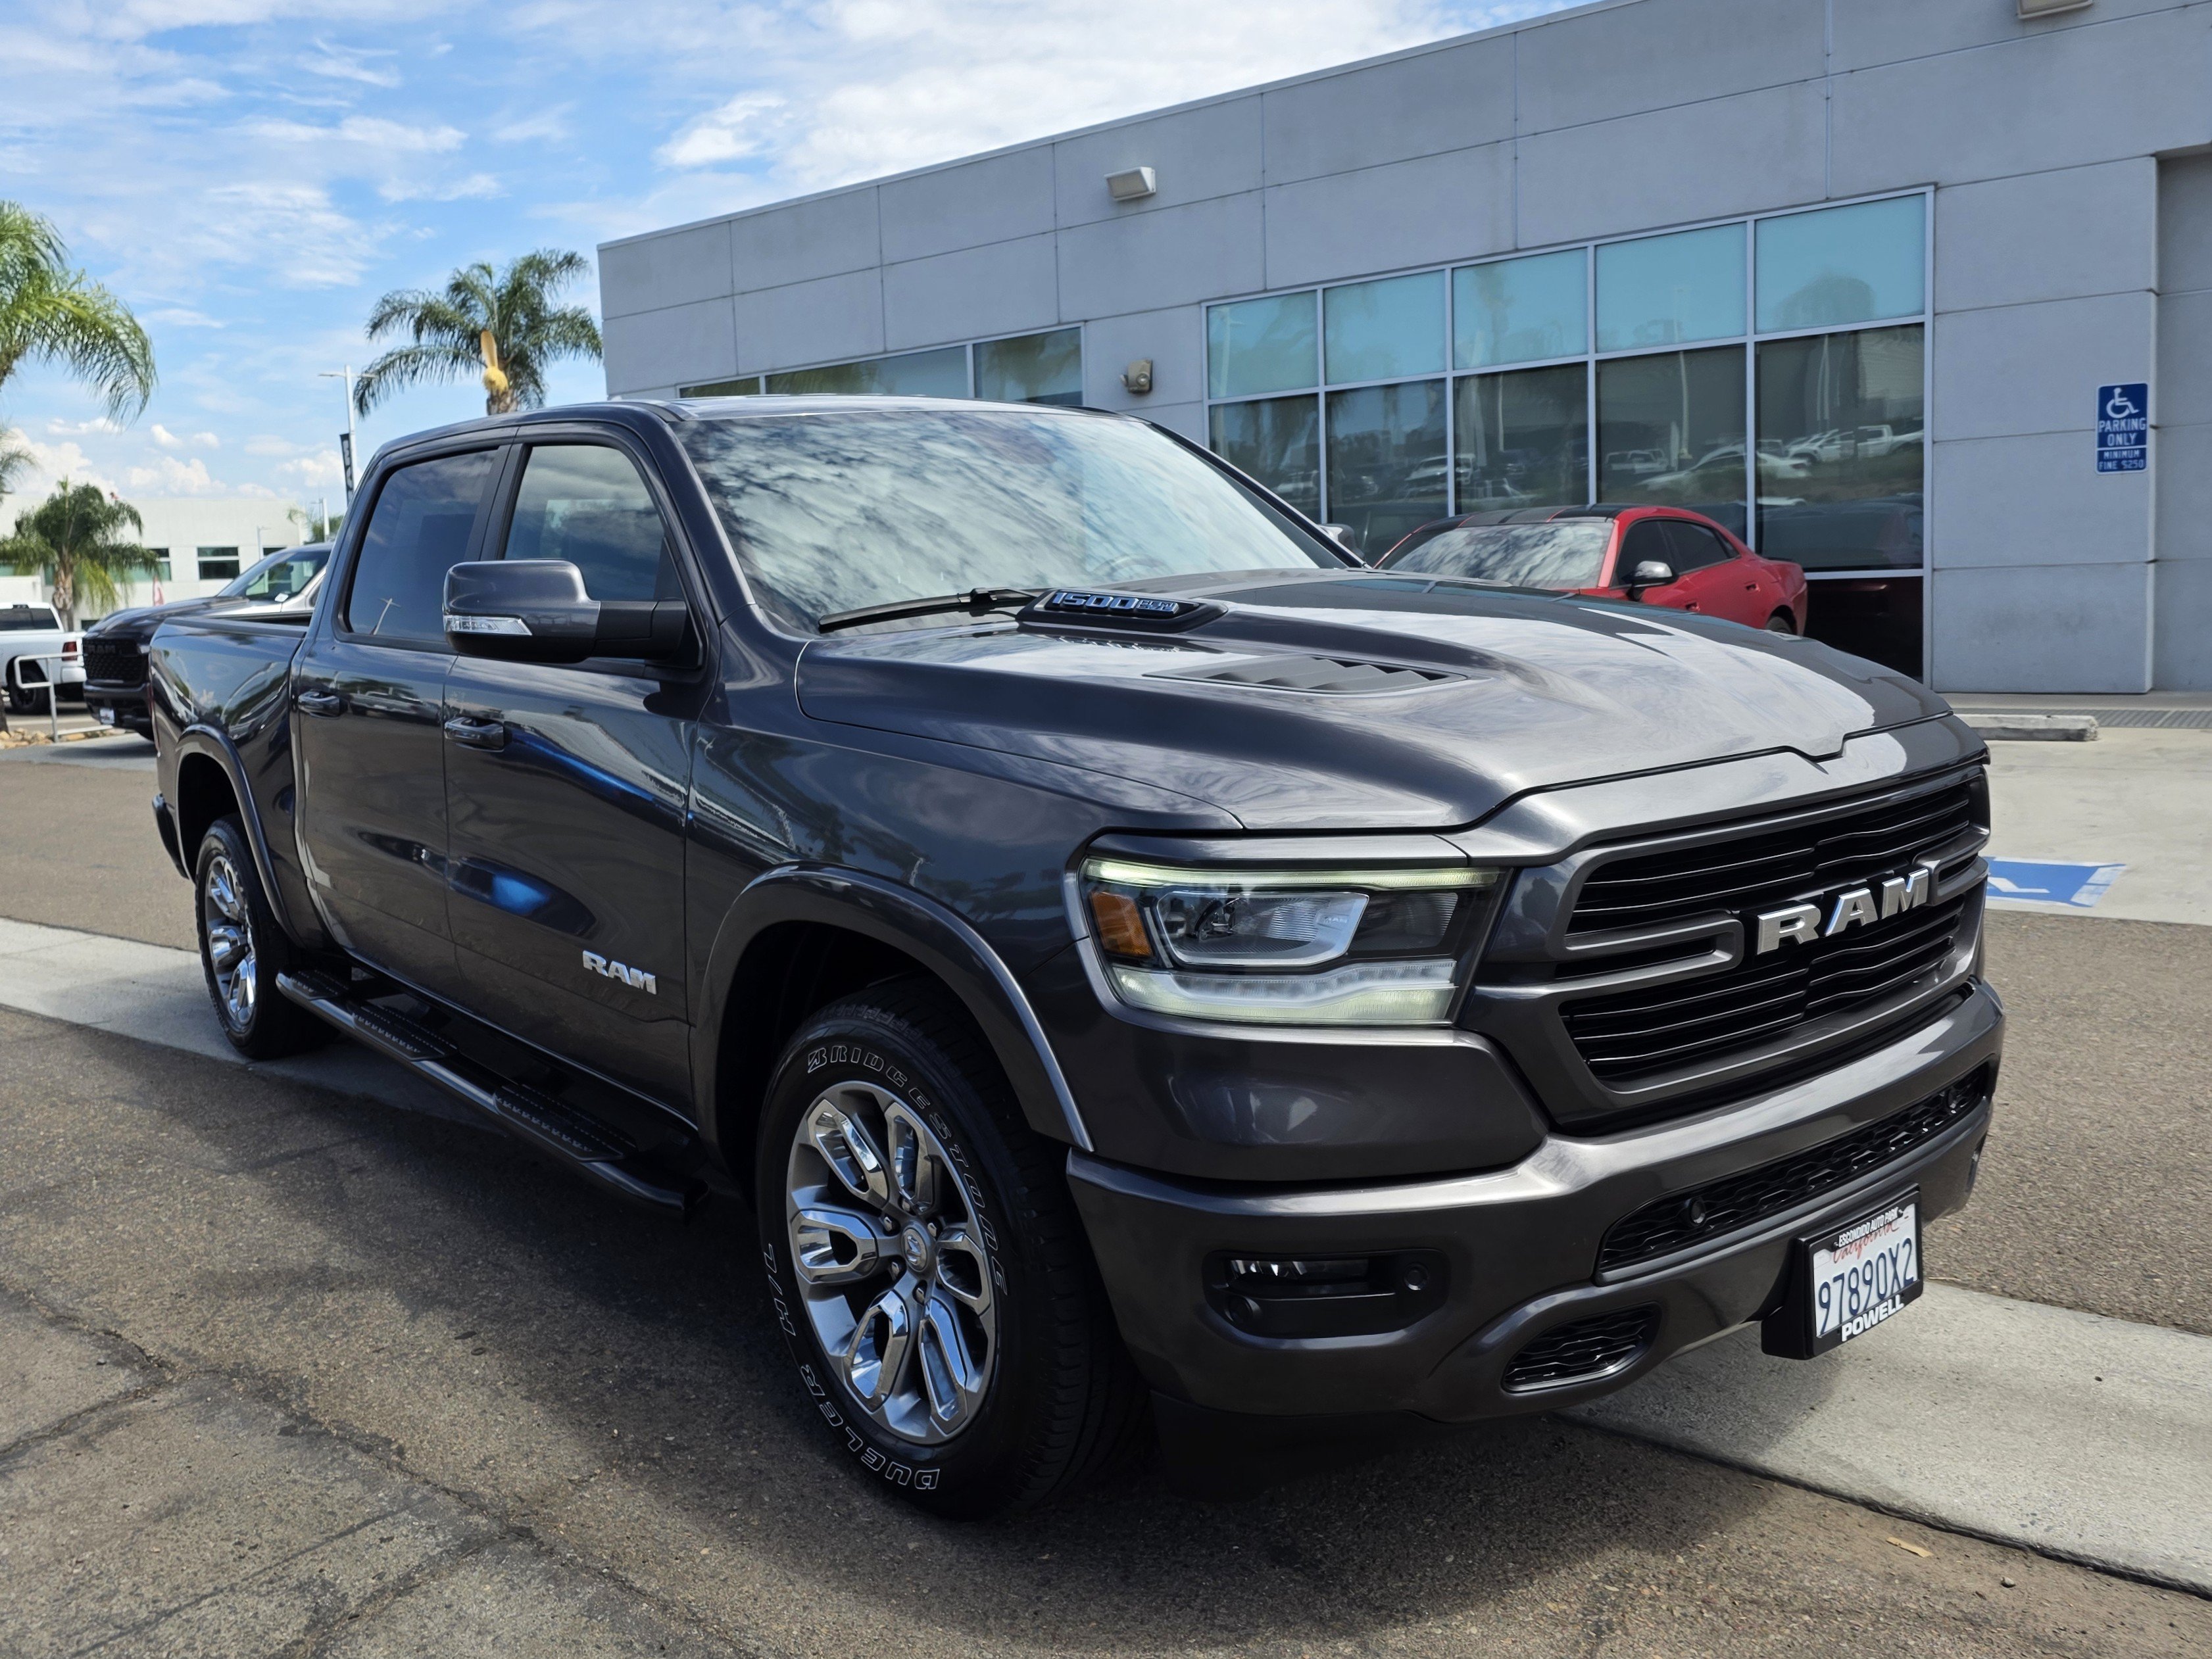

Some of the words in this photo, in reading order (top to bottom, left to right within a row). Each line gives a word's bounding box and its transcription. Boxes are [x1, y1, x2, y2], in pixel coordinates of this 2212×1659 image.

[2098, 418, 2146, 433] PARKING
[2107, 433, 2137, 446] ONLY
[2098, 461, 2117, 471] FINE
[2121, 459, 2144, 469] $250
[2103, 450, 2140, 459] MINIMUM
[1052, 592, 1139, 610] 1500
[1757, 868, 1929, 955] RAM
[583, 950, 656, 995] RAM
[808, 1046, 1008, 1296] BRIDGESTONE
[1870, 1214, 1885, 1232] AUTO
[1818, 1238, 1914, 1335] 97890X2
[1842, 1293, 1904, 1342] POWELL
[800, 1364, 941, 1490] DUELER
